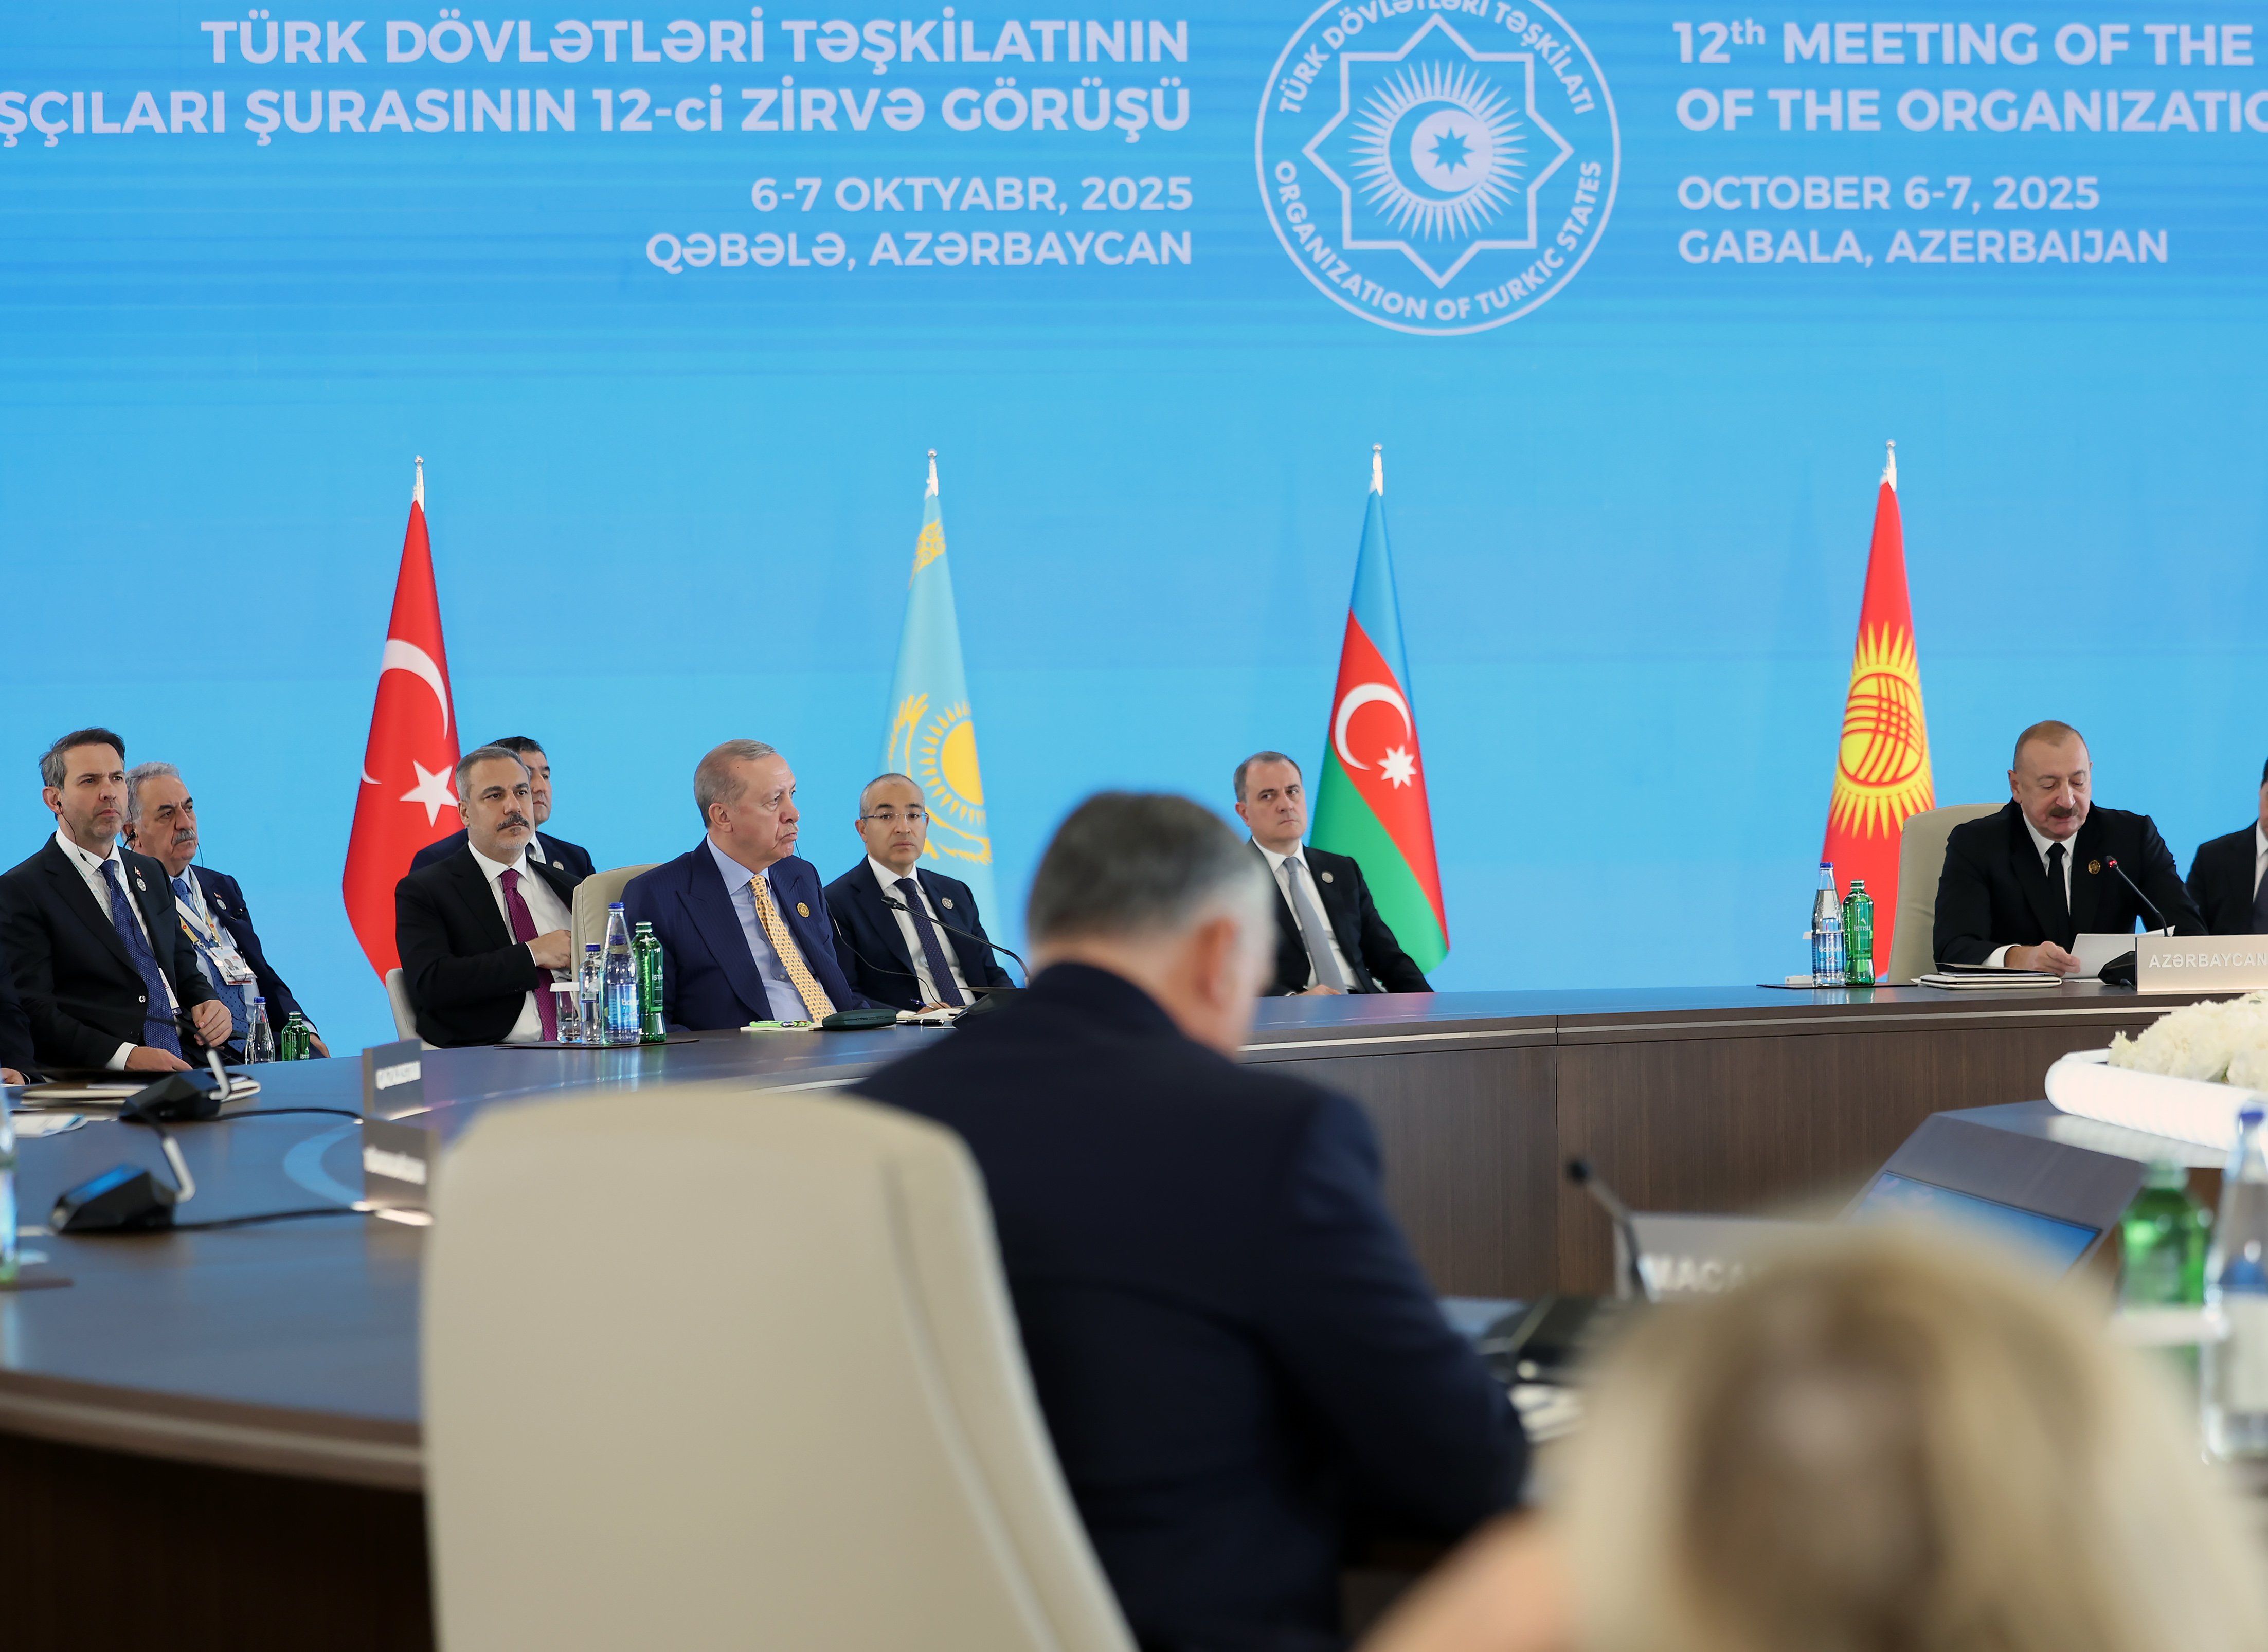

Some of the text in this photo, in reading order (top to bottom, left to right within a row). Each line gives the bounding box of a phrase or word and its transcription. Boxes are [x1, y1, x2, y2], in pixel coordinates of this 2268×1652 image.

[201, 6, 1188, 75] TÜRK DÖVLƏTLƏRİ TƏŞKİLATININ
[1279, 43, 1330, 113] TÜRK
[1495, 2, 1595, 114] TƏŞKİLATI
[1673, 19, 2254, 66] 12th MEETING OF THE
[0, 75, 1190, 148] ŞÇILARI ŞURASININ 12-ci ZİRVƏ GÖRÜŞÜ
[1677, 88, 1753, 131] OF
[1768, 89, 1881, 131] THE
[752, 176, 1193, 215] 6-7 OKTYABR, 2025
[1678, 176, 2099, 214] OCTOBER 6-7, 2025
[646, 231, 1191, 274] QƏBƏLƏ, AZƏRBAYCAN
[1275, 161, 1601, 321] ORGANIZATION OF TURKIC STATES
[1679, 230, 2167, 267] GABALA, AZERBAIJAN
[2148, 952, 2267, 968] AZƏRBAYCAN
